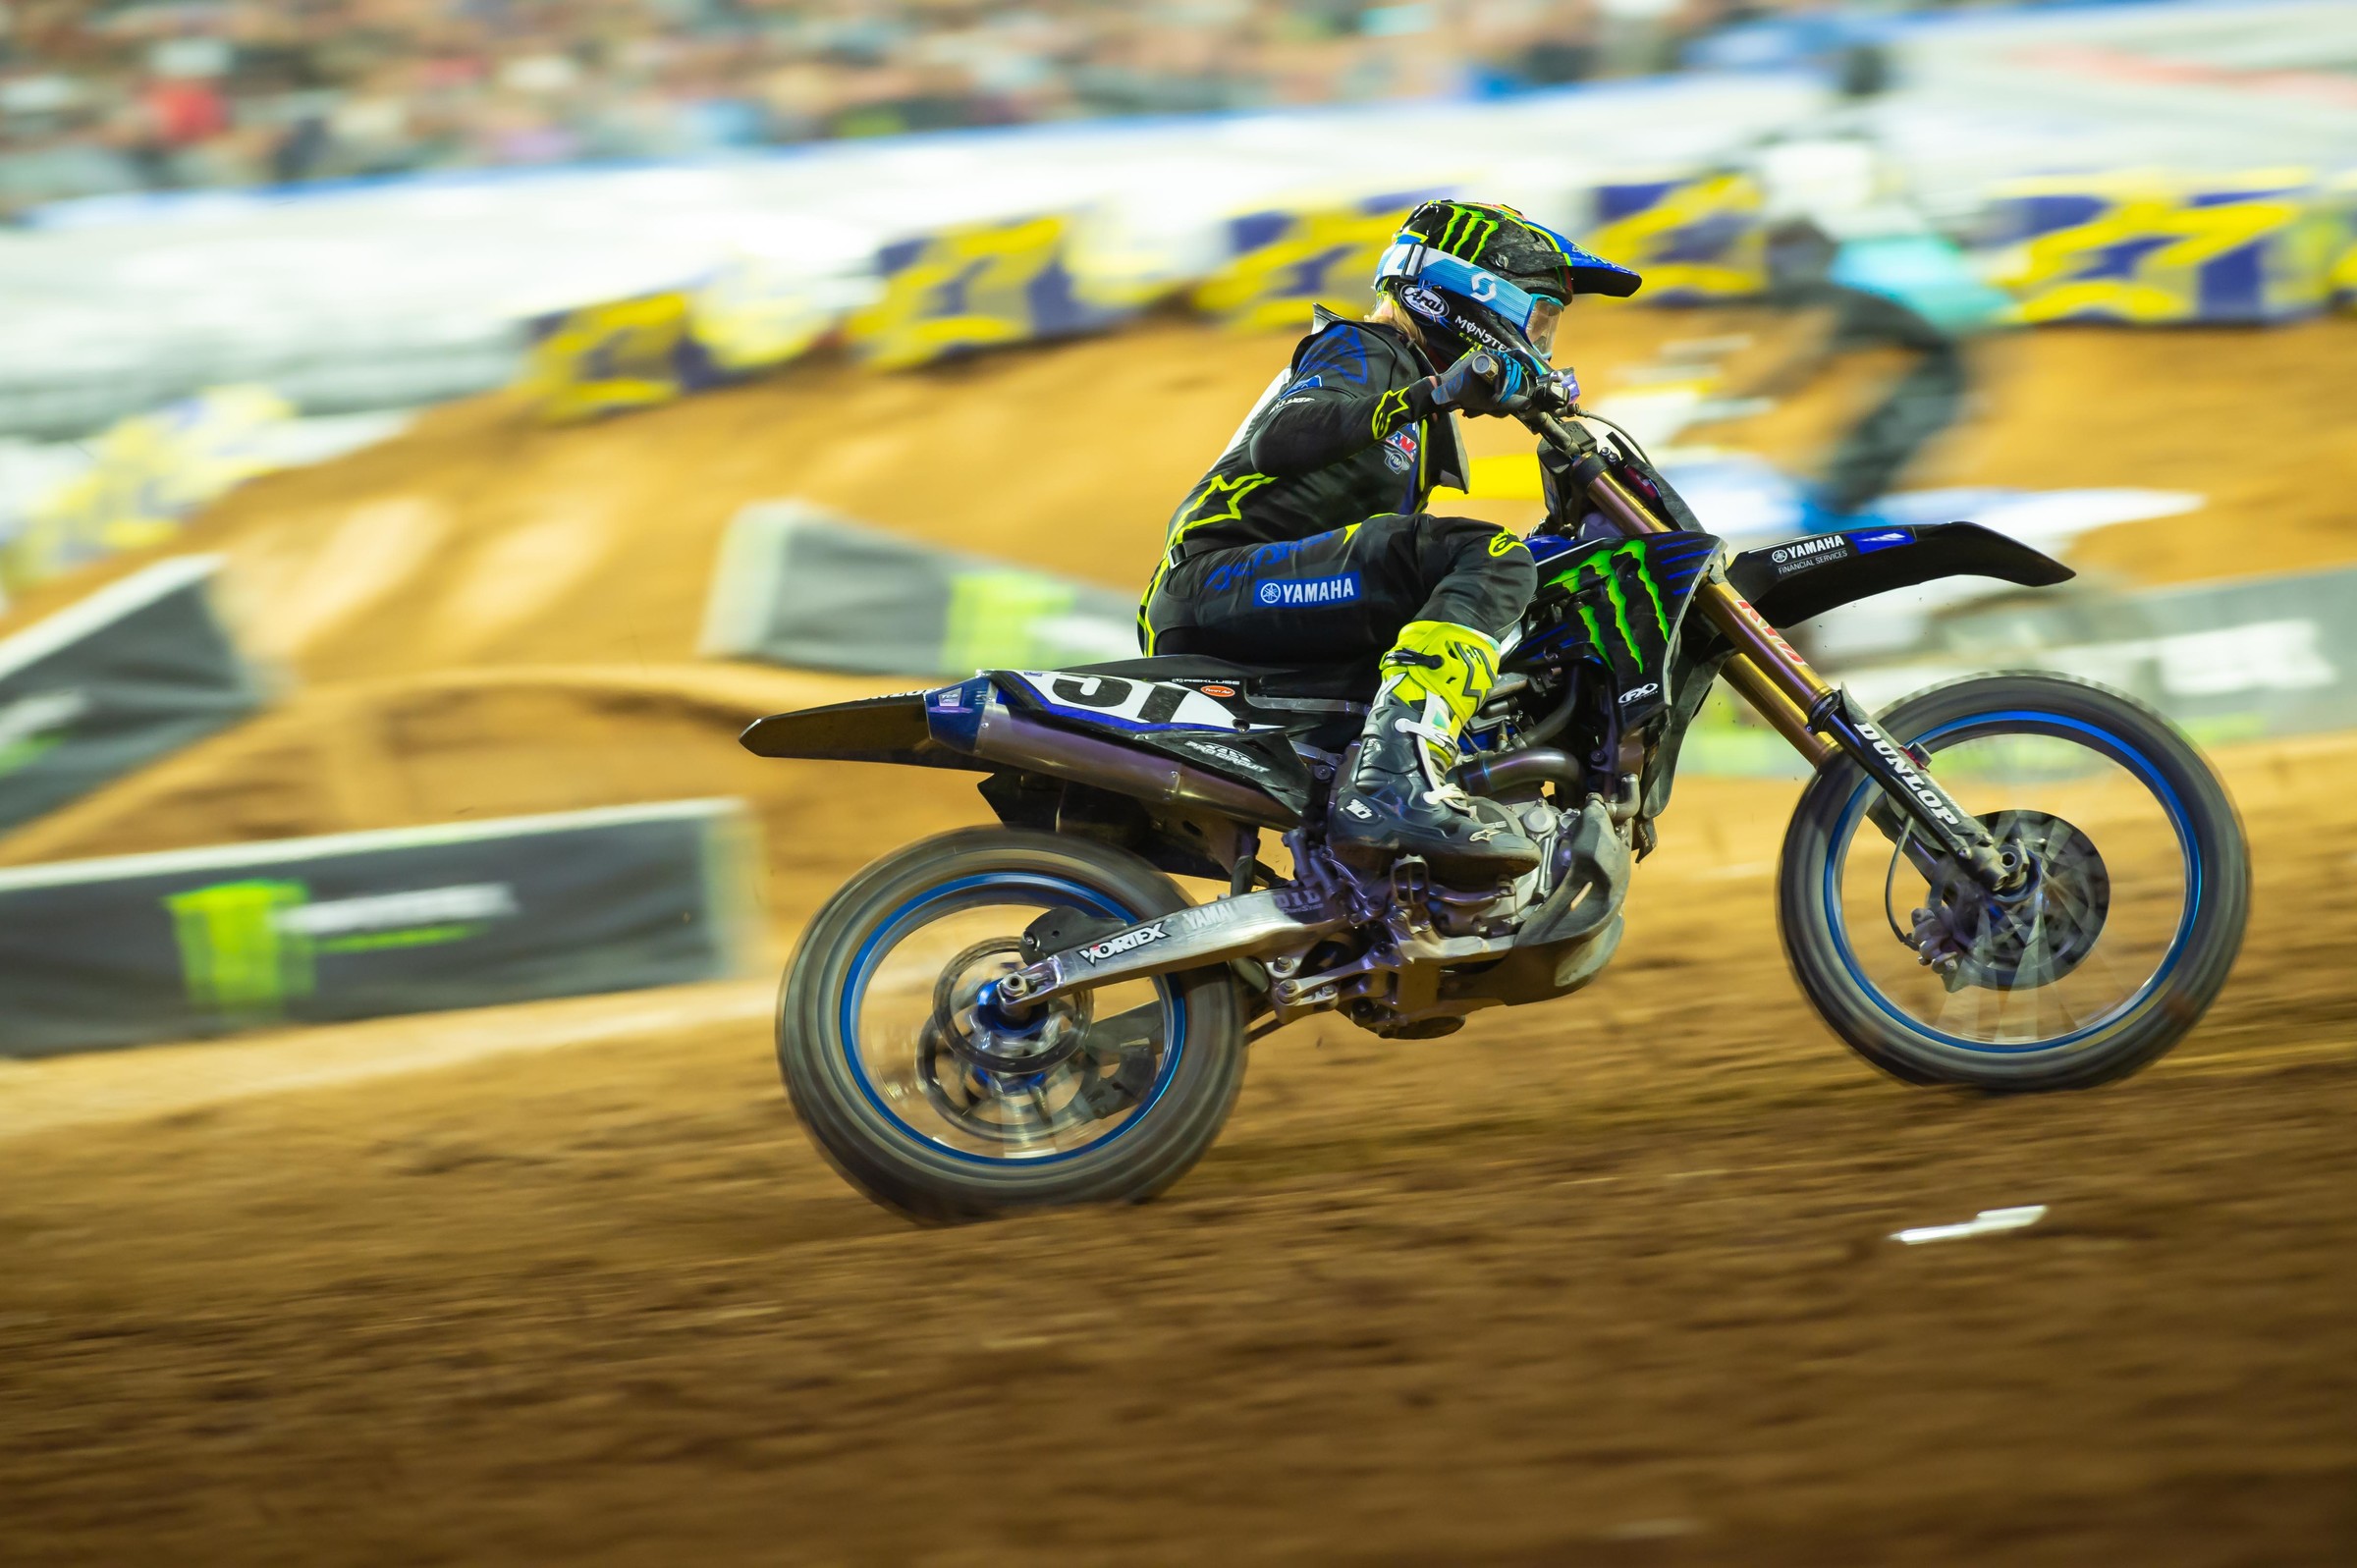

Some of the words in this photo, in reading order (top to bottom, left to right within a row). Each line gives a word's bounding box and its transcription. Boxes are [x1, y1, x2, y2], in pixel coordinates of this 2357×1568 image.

[1404, 289, 1445, 312] Arai
[1786, 534, 1844, 559] YAMAHA
[1779, 559, 1815, 574] FINANCIAL
[1816, 550, 1848, 565] SERVICES
[1283, 577, 1354, 603] YAMAHA
[1184, 740, 1217, 755] PRO
[1216, 752, 1271, 773] CIRCUIT
[1853, 723, 1959, 825] DUNLOP
[1077, 922, 1170, 966] VORTEX
